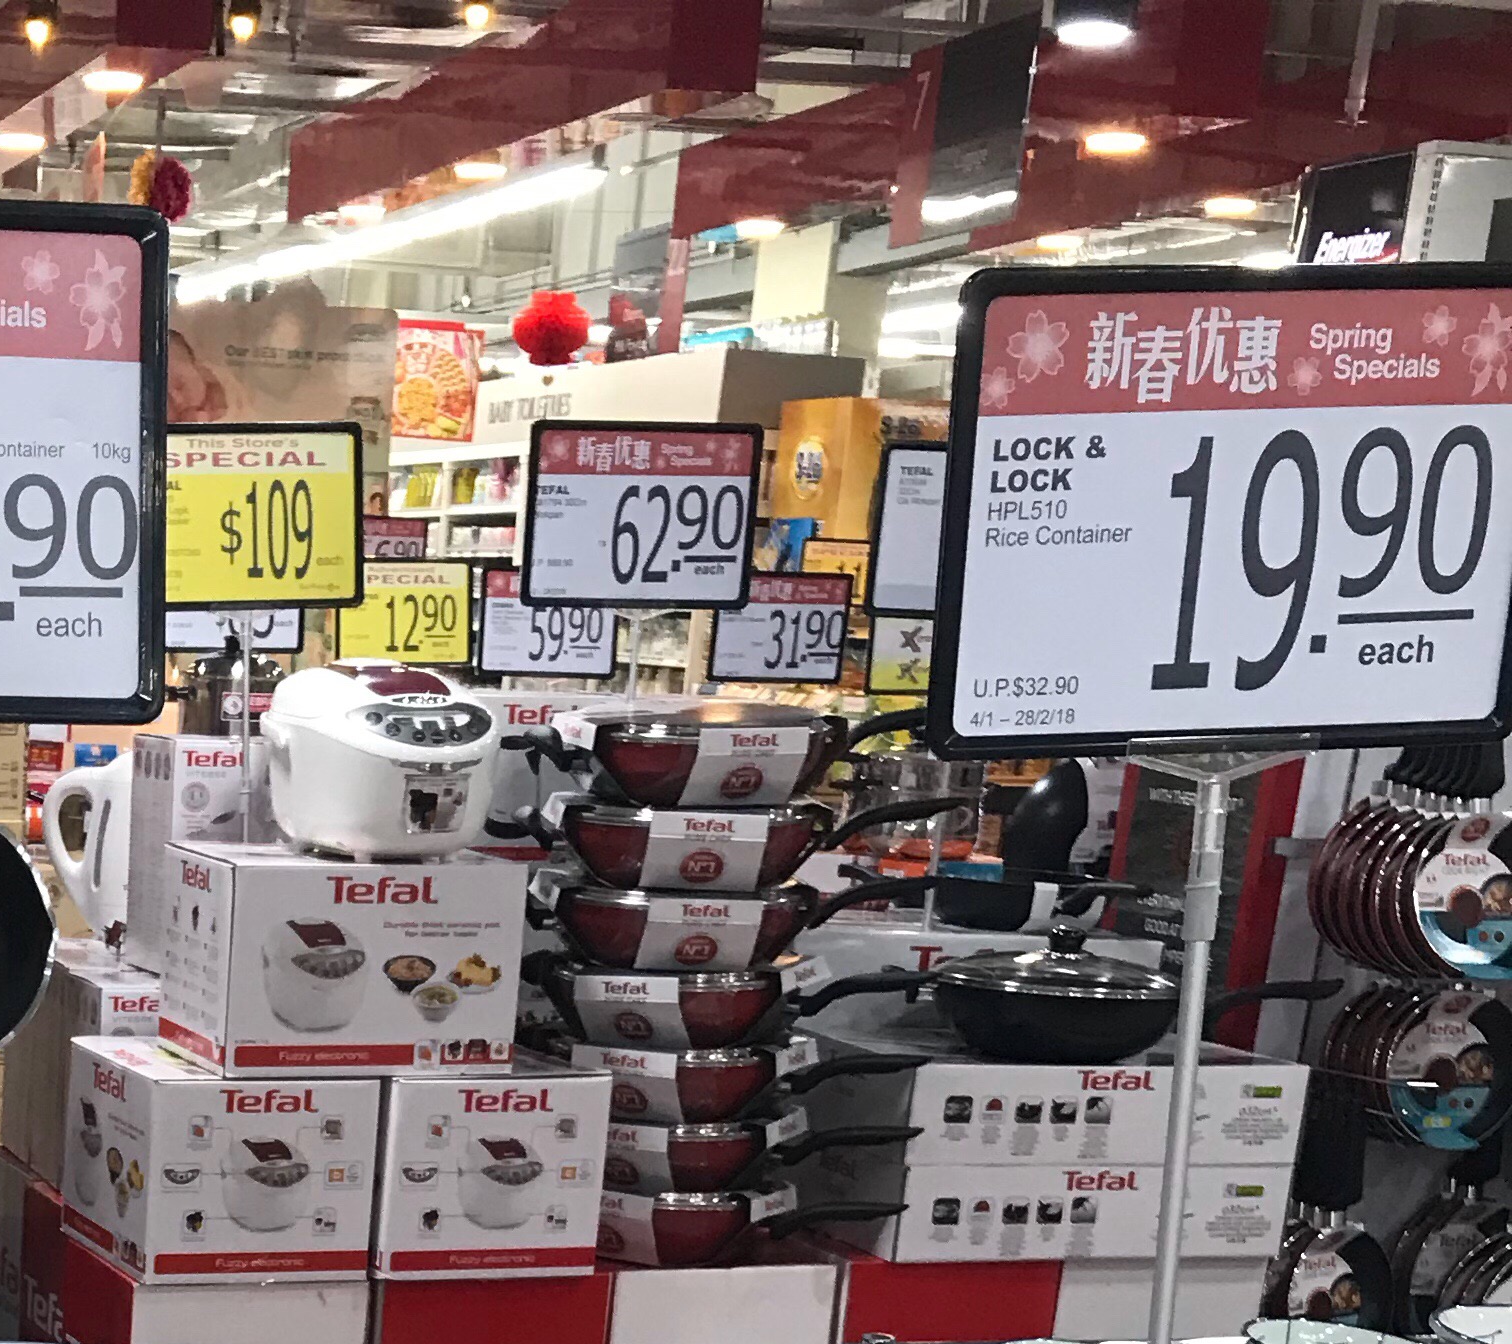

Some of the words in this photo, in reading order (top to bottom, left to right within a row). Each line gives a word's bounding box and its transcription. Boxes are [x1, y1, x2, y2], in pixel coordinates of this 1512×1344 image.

[1309, 321, 1393, 356] Spring
[1084, 306, 1283, 404] 新春优惠
[1333, 352, 1441, 386] Specials
[91, 442, 132, 464] 10kg
[185, 437, 226, 449] This
[230, 437, 300, 449] Store's
[576, 435, 652, 473] 新春优惠
[992, 435, 1077, 463] LOCK
[1085, 434, 1107, 460] &
[166, 450, 328, 468] SPECIAL
[989, 467, 1073, 494] LOCK
[987, 499, 1068, 522] HPL510
[220, 479, 314, 580] $109
[611, 484, 745, 586] 62.90
[984, 527, 1030, 548] Rice
[1035, 523, 1133, 546] Container
[1151, 424, 1494, 692] 19.90
[366, 573, 451, 586] PECIAL
[36, 611, 103, 638] each
[385, 594, 458, 653] 12.90
[527, 606, 603, 663] 59.90
[763, 609, 846, 670] 31.90
[1357, 634, 1435, 666] each
[973, 675, 1080, 699] U.P.$32.90
[969, 710, 994, 728] 4/1
[1014, 707, 1076, 727] 28/2/18
[729, 733, 780, 748] Tefal
[183, 749, 245, 768] Tefal
[683, 817, 735, 833] Tefal
[180, 859, 213, 894] Tefal
[326, 874, 439, 905] Tefal
[680, 903, 731, 919] Tefal
[601, 980, 650, 995] Tefal
[108, 996, 160, 1014] Tefa
[600, 1052, 648, 1070] Tefal
[92, 1061, 127, 1103] Tefal
[1077, 1069, 1156, 1092] Tefal
[218, 1088, 319, 1114] Tefal
[458, 1088, 554, 1113] Tefal
[607, 1128, 639, 1144] efal
[1062, 1169, 1139, 1192] Tefal
